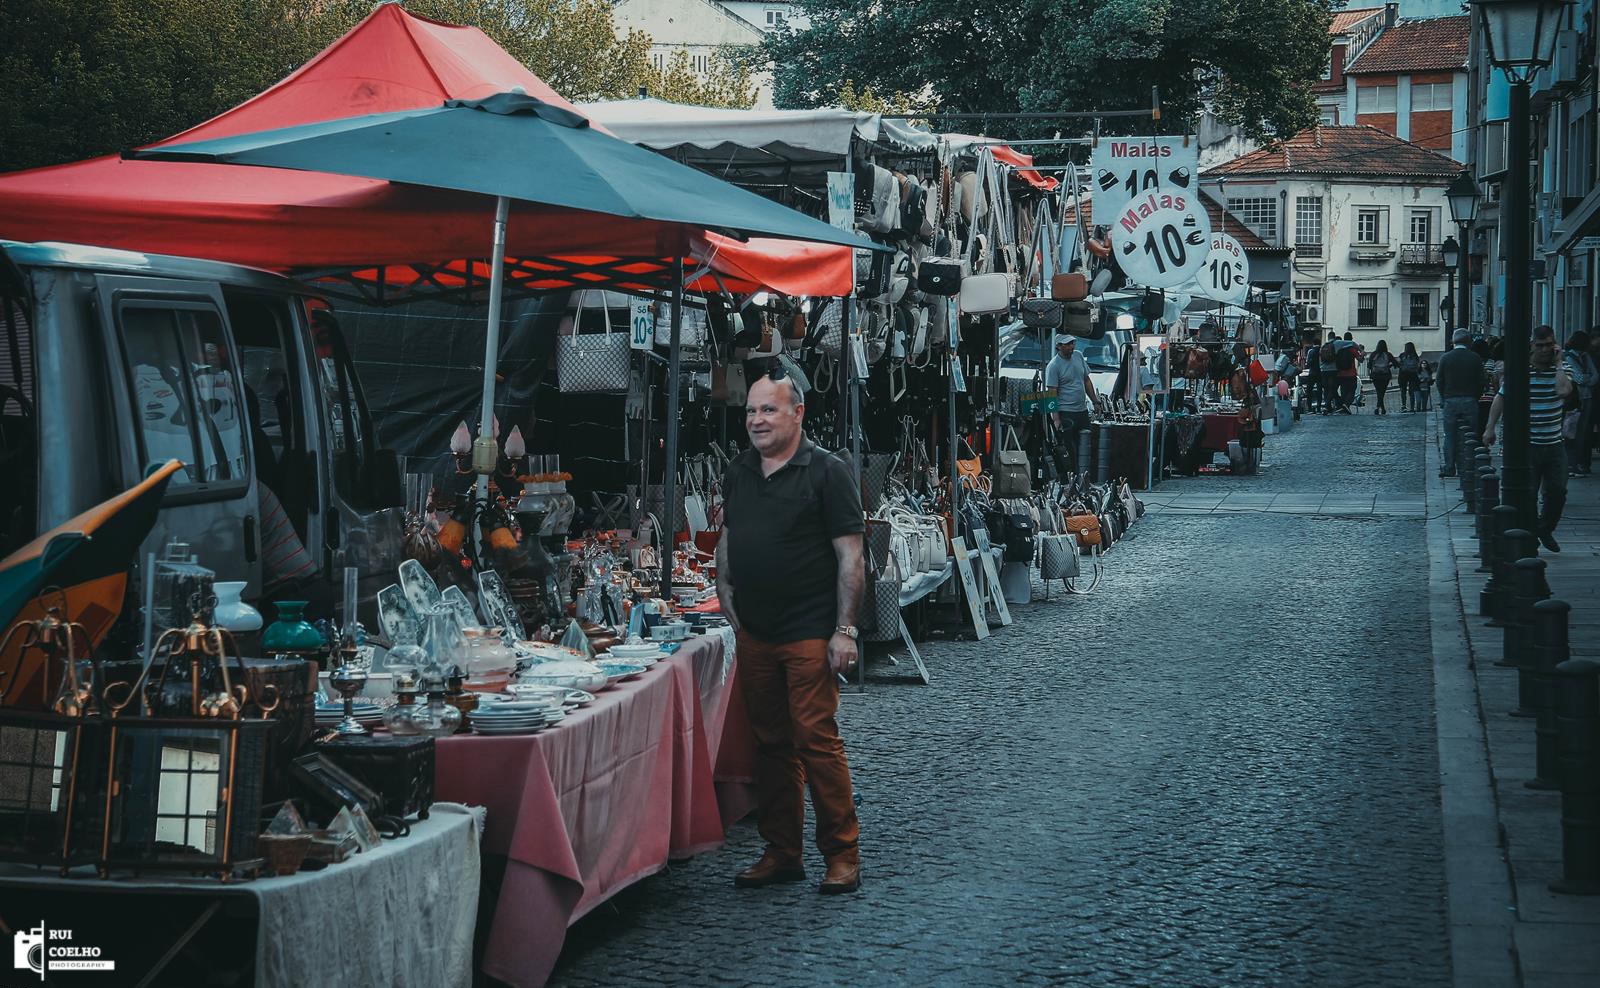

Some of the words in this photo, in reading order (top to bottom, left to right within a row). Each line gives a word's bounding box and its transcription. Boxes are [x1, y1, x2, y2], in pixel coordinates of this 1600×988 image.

[1111, 142, 1171, 158] Malas
[1120, 194, 1185, 234] Malas
[1210, 237, 1240, 258] alas
